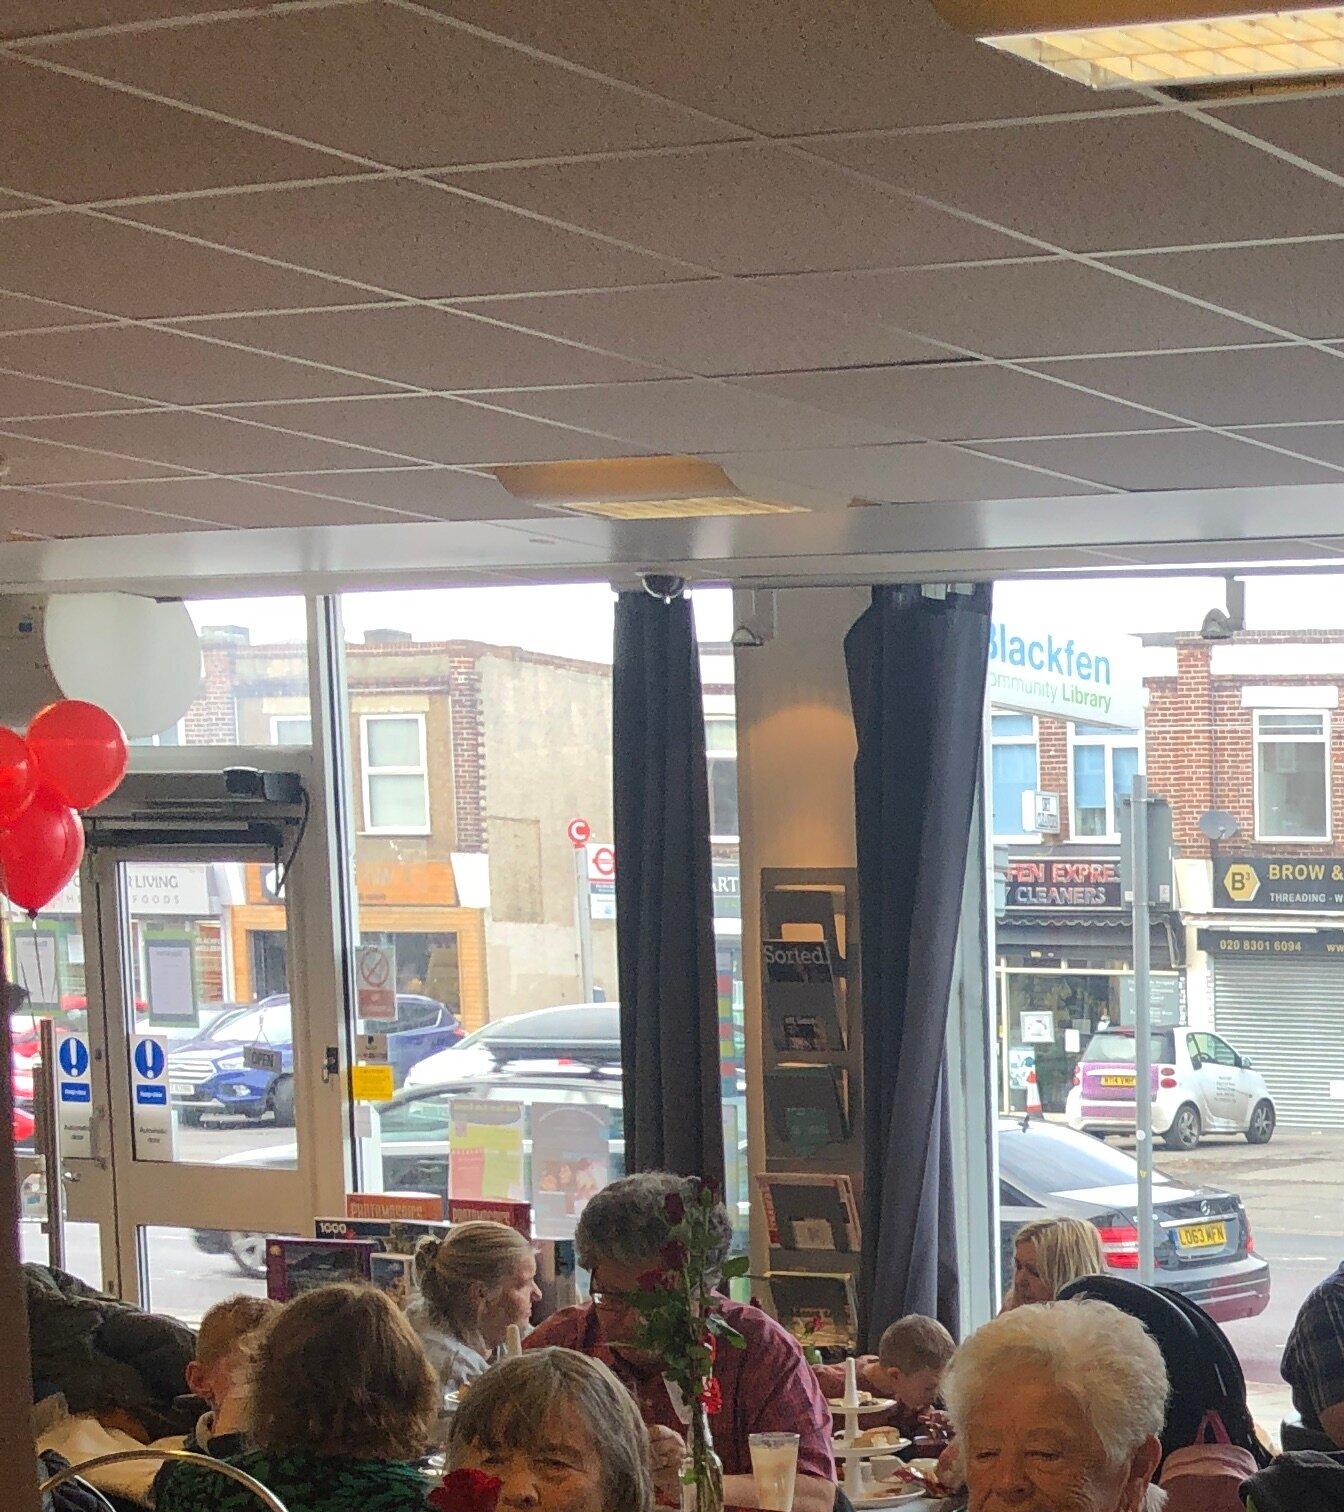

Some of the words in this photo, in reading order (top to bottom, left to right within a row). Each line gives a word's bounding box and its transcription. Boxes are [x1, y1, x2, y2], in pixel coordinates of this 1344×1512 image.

[1062, 683, 1112, 714] Library
[1268, 864, 1325, 881] BROW
[1331, 865, 1344, 881] &
[135, 875, 179, 888] LIVING
[132, 895, 180, 904] FOODS
[1016, 885, 1107, 905] CLEANERS
[1270, 892, 1326, 903] THREADING
[1220, 939, 1240, 951] 020
[1243, 940, 1271, 951] 8301
[1273, 941, 1302, 952] 6094
[319, 1222, 348, 1234] 1000
